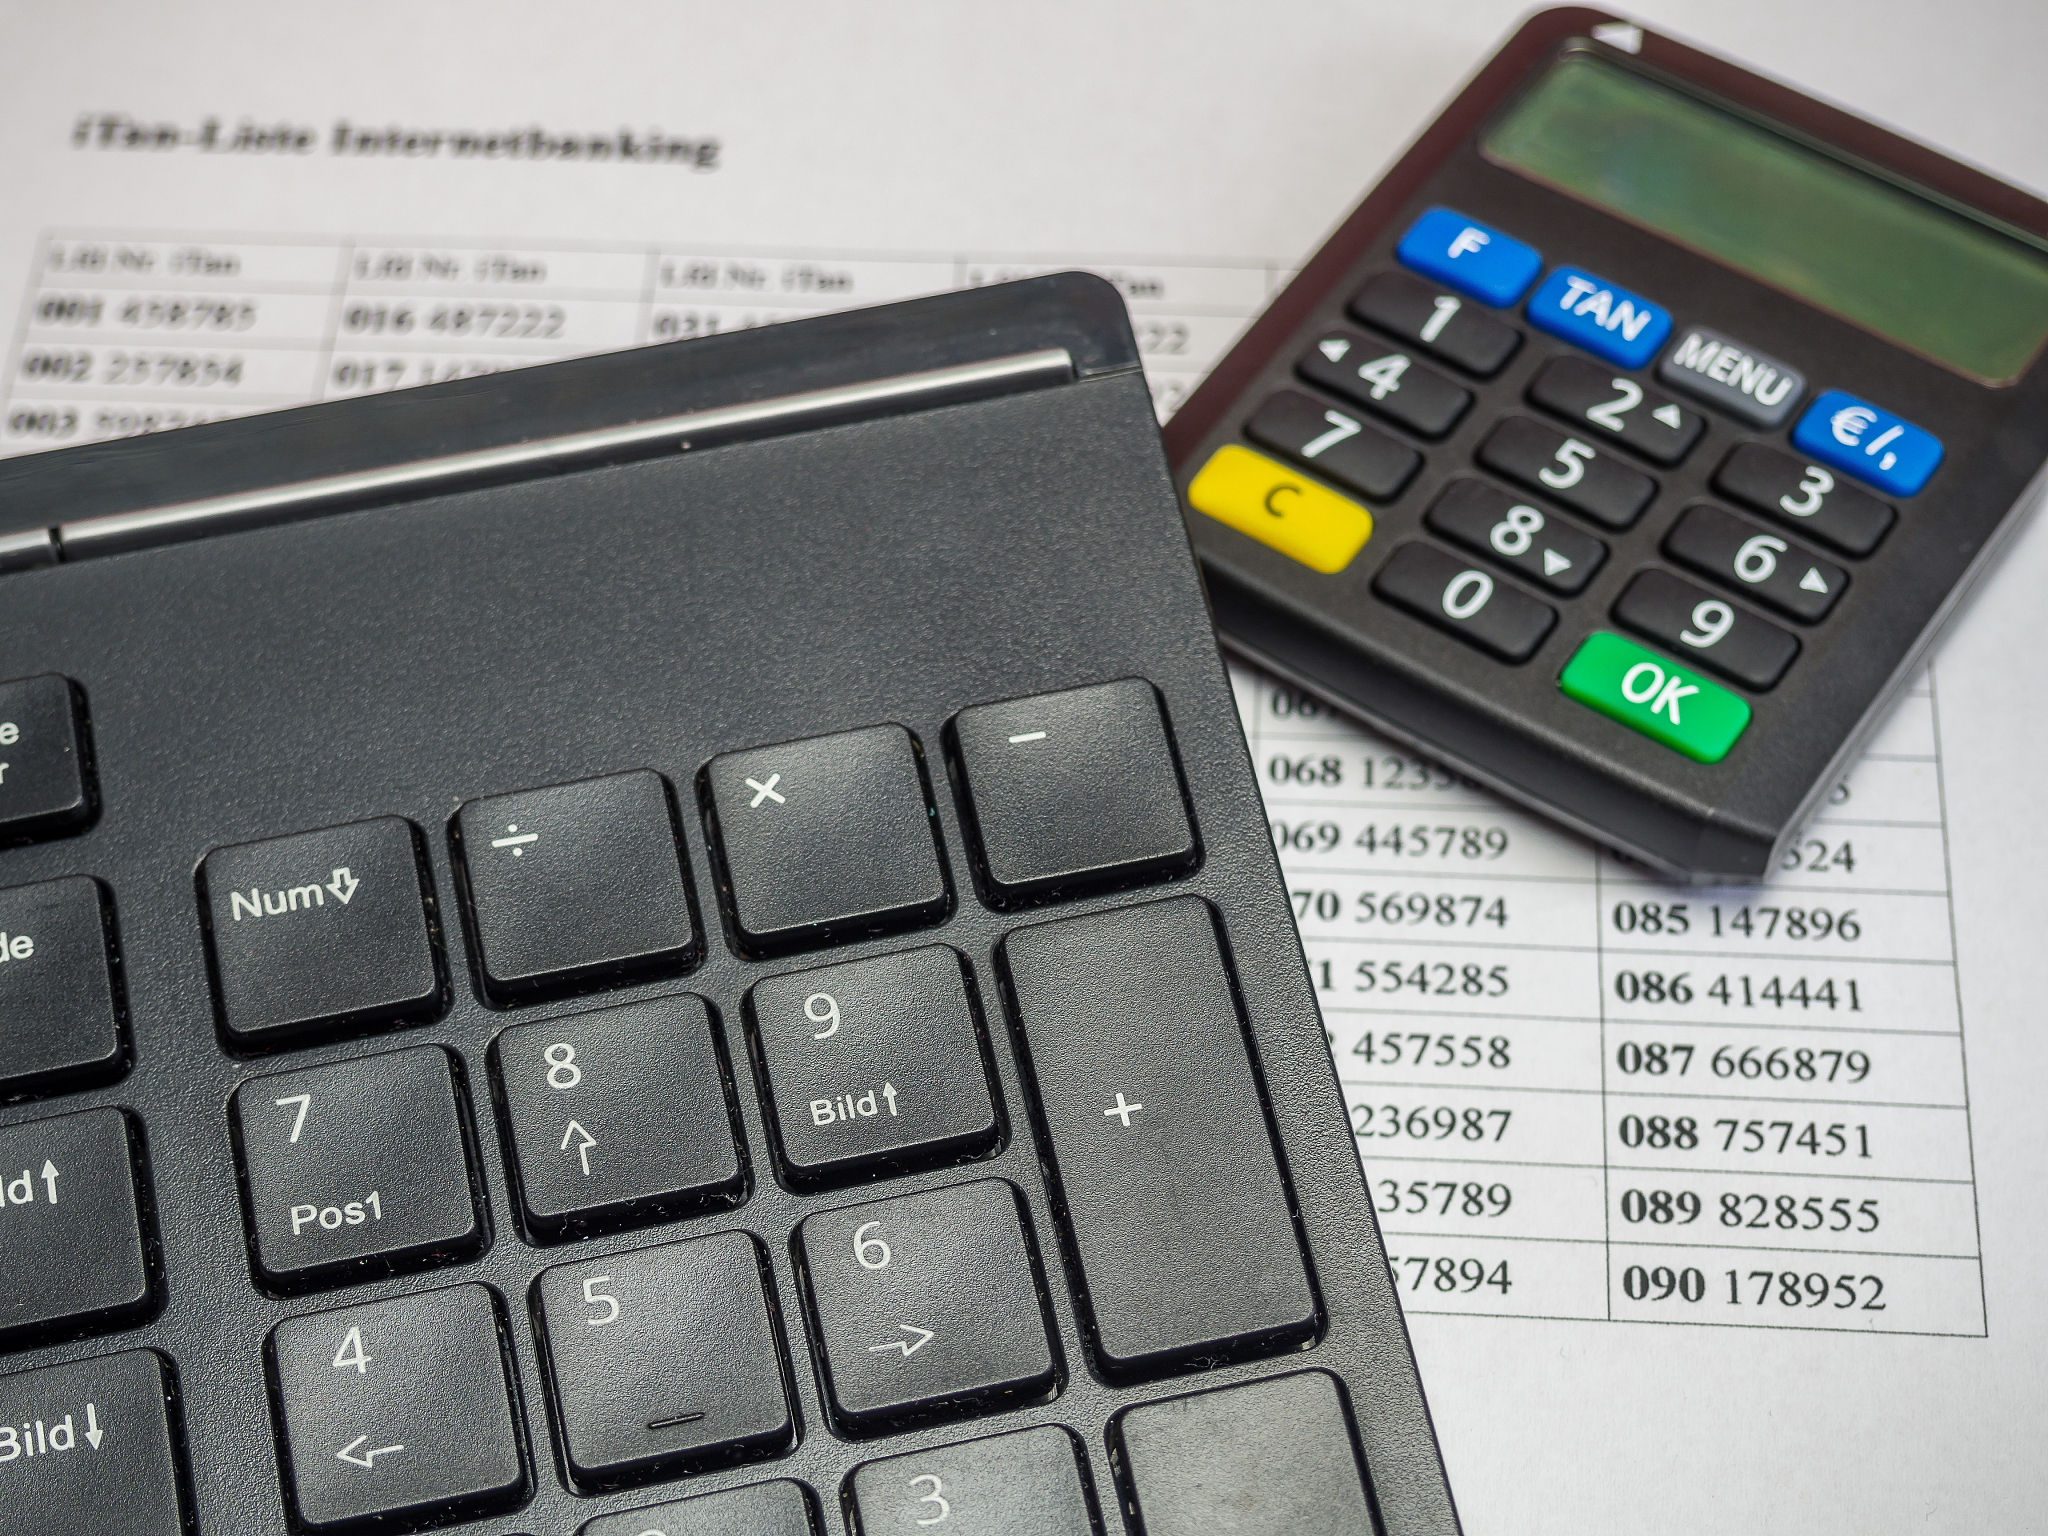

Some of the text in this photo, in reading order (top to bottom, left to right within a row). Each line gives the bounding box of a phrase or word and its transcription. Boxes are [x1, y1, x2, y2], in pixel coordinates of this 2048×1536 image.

[331, 118, 721, 172] Internetbanking
[1448, 227, 1489, 259] F
[343, 302, 416, 334] 016
[1421, 296, 1460, 342] 1
[1559, 276, 1652, 342] TAN
[1358, 355, 1410, 400] 4
[1671, 332, 1795, 408] MENU
[1586, 378, 1643, 432] 2
[1302, 410, 1361, 458] 7
[1539, 439, 1595, 489] 5
[1263, 483, 1301, 519] C
[1780, 466, 1834, 517] 3
[1490, 505, 1545, 556] 8
[1734, 536, 1787, 583] 6
[1442, 571, 1493, 619] 0
[1680, 601, 1734, 648] 9
[1620, 661, 1700, 726] OK
[1266, 755, 1344, 787] 068
[1353, 823, 1509, 860] 445789
[230, 884, 324, 921] Num
[1355, 890, 1509, 929] 569874
[1612, 900, 1862, 942] 085 147896
[1356, 961, 1509, 997] 554285
[1614, 971, 1860, 1012] 086 414441
[804, 992, 841, 1040] 9
[543, 1042, 582, 1090] 8
[1352, 1031, 1511, 1069] 457558
[1617, 1042, 1871, 1082] 087 666879
[275, 1093, 311, 1143] 7
[809, 1089, 878, 1126] Bild
[1352, 1104, 1513, 1143] 236987
[1618, 1115, 1871, 1158] 088 757451
[290, 1190, 382, 1236] Pos1
[1377, 1179, 1513, 1219] 35789
[1620, 1189, 1880, 1233] 089 828555
[853, 1220, 892, 1270] 6
[582, 1275, 620, 1326] 5
[1622, 1265, 1887, 1311] 090 178952
[332, 1326, 372, 1374] 4
[909, 1474, 951, 1527] 3
